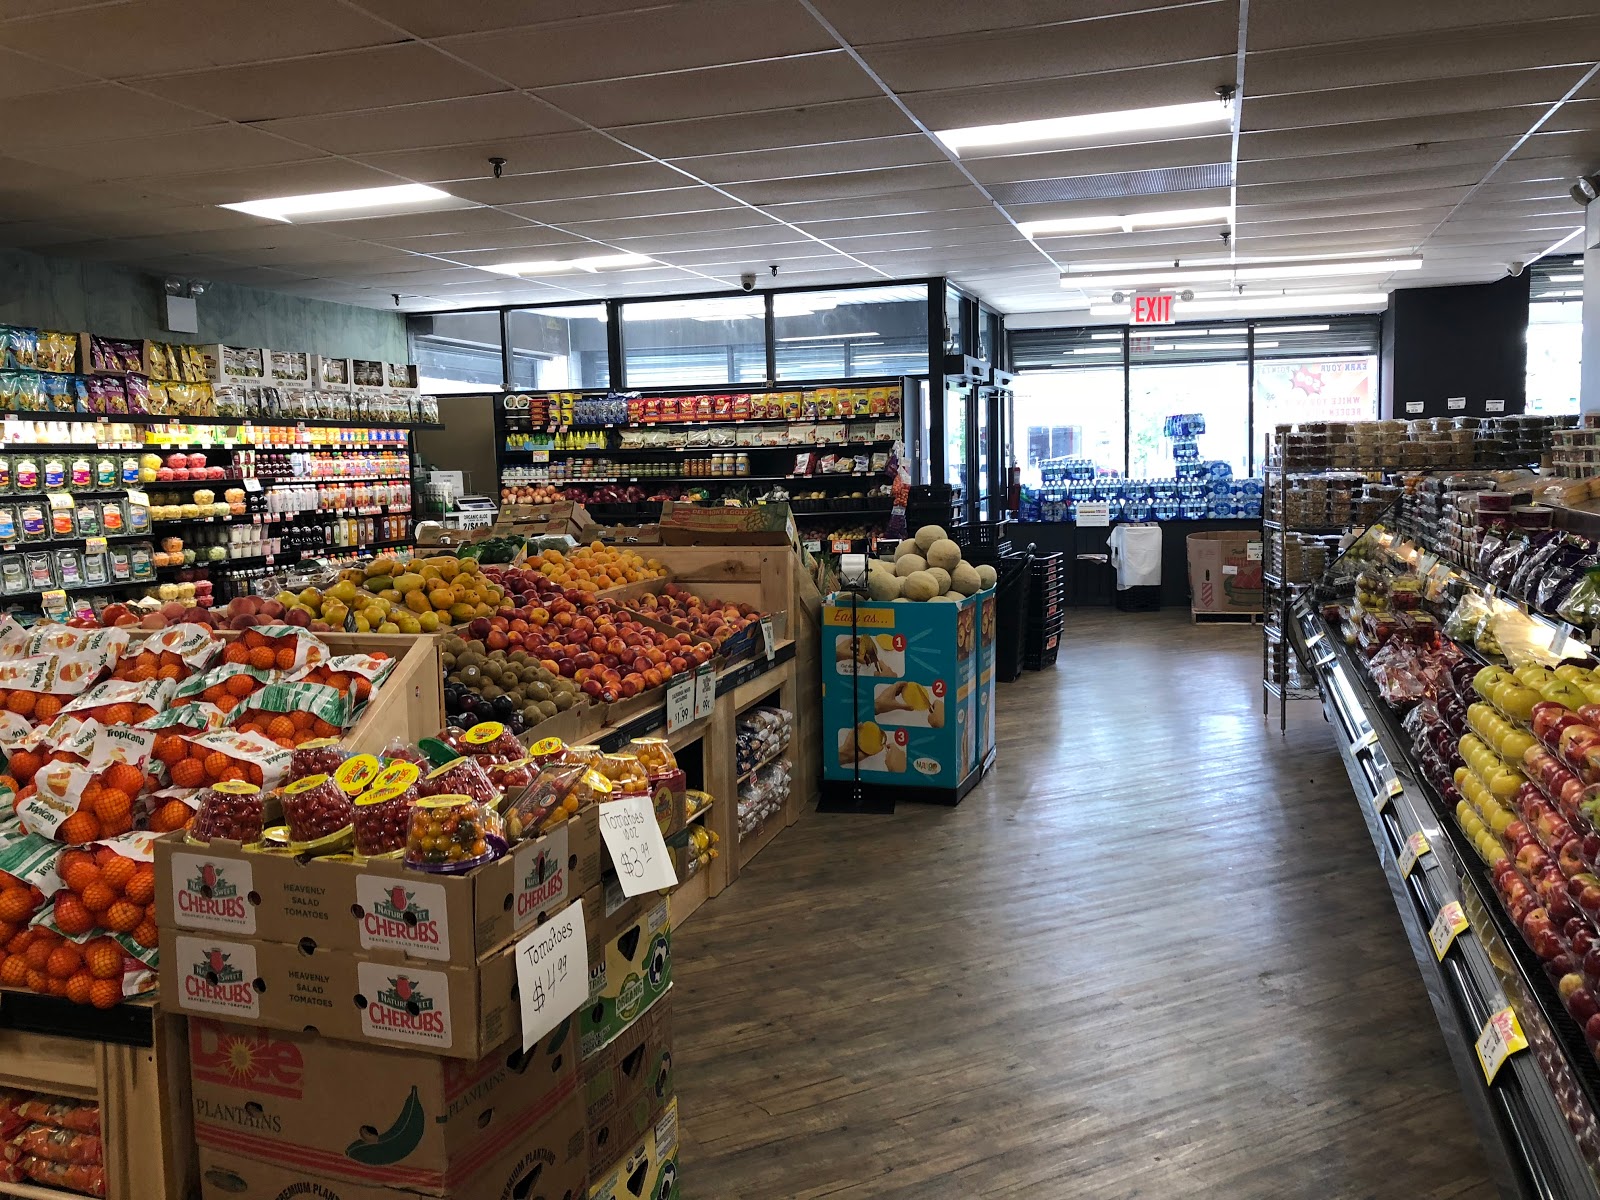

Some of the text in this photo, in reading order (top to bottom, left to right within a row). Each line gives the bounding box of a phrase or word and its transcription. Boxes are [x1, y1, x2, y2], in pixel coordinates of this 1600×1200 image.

[1135, 295, 1173, 323] EXIT
[896, 636, 903, 648] 1
[935, 682, 943, 694] 2
[106, 727, 146, 747] Tropicana
[897, 731, 905, 744] 3
[25, 801, 59, 826] Tropicana
[600, 807, 645, 830] Tomatoes
[283, 883, 326, 896] HEAVENLY
[517, 868, 563, 917] CHERUBS
[177, 889, 246, 919] CHERUBS
[291, 896, 320, 907] SALAD
[283, 907, 329, 921] TOMATOES
[364, 911, 439, 945] CHERUBS
[524, 921, 574, 968] Tomatoes
[288, 970, 330, 984] HEAVENLY
[185, 974, 253, 1005] CHERUBS
[296, 983, 324, 995] SALAD
[617, 979, 643, 1010] ORGANIC
[288, 994, 333, 1008] TOMATOES
[368, 1001, 444, 1034] CHERUBS
